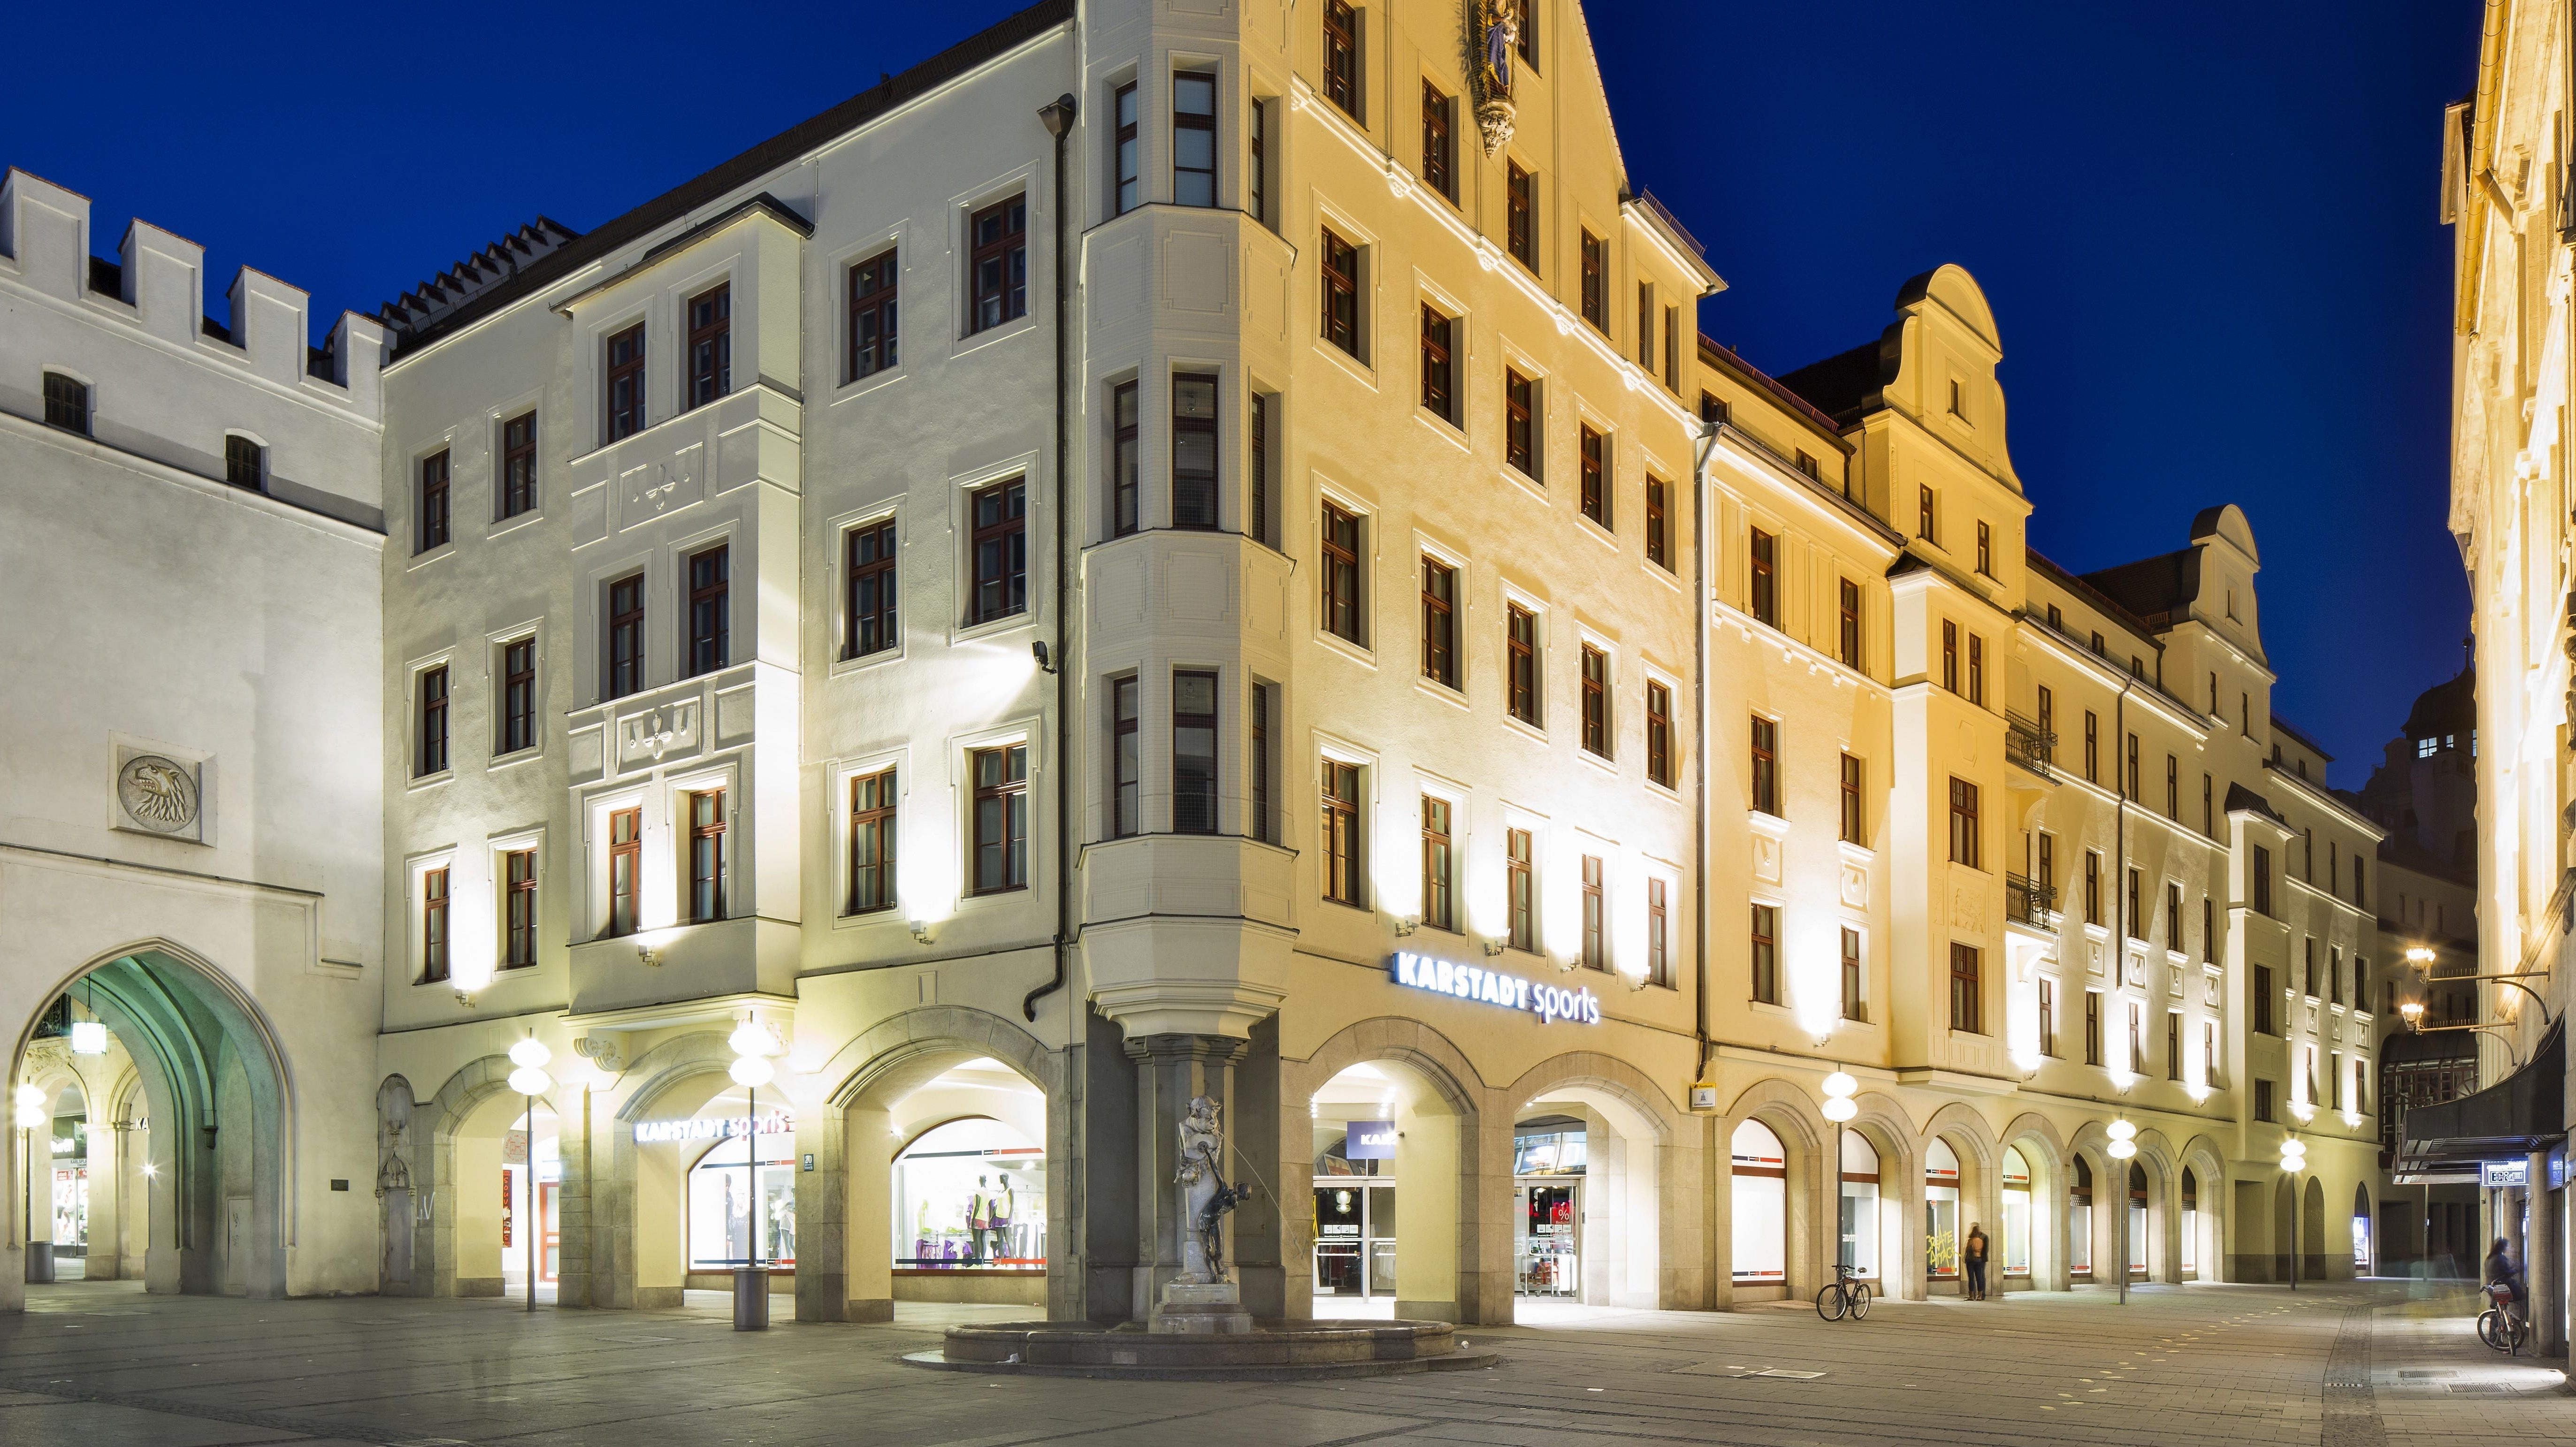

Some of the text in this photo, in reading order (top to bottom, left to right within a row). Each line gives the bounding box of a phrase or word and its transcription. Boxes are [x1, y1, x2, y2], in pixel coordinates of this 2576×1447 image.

[1398, 952, 1599, 1024] KARSTADT sports
[636, 1118, 726, 1142] KARSTADT
[805, 1155, 812, 1164] 20
[1926, 1224, 1953, 1254] CREATE
[1930, 1242, 1961, 1268] ATTACK
